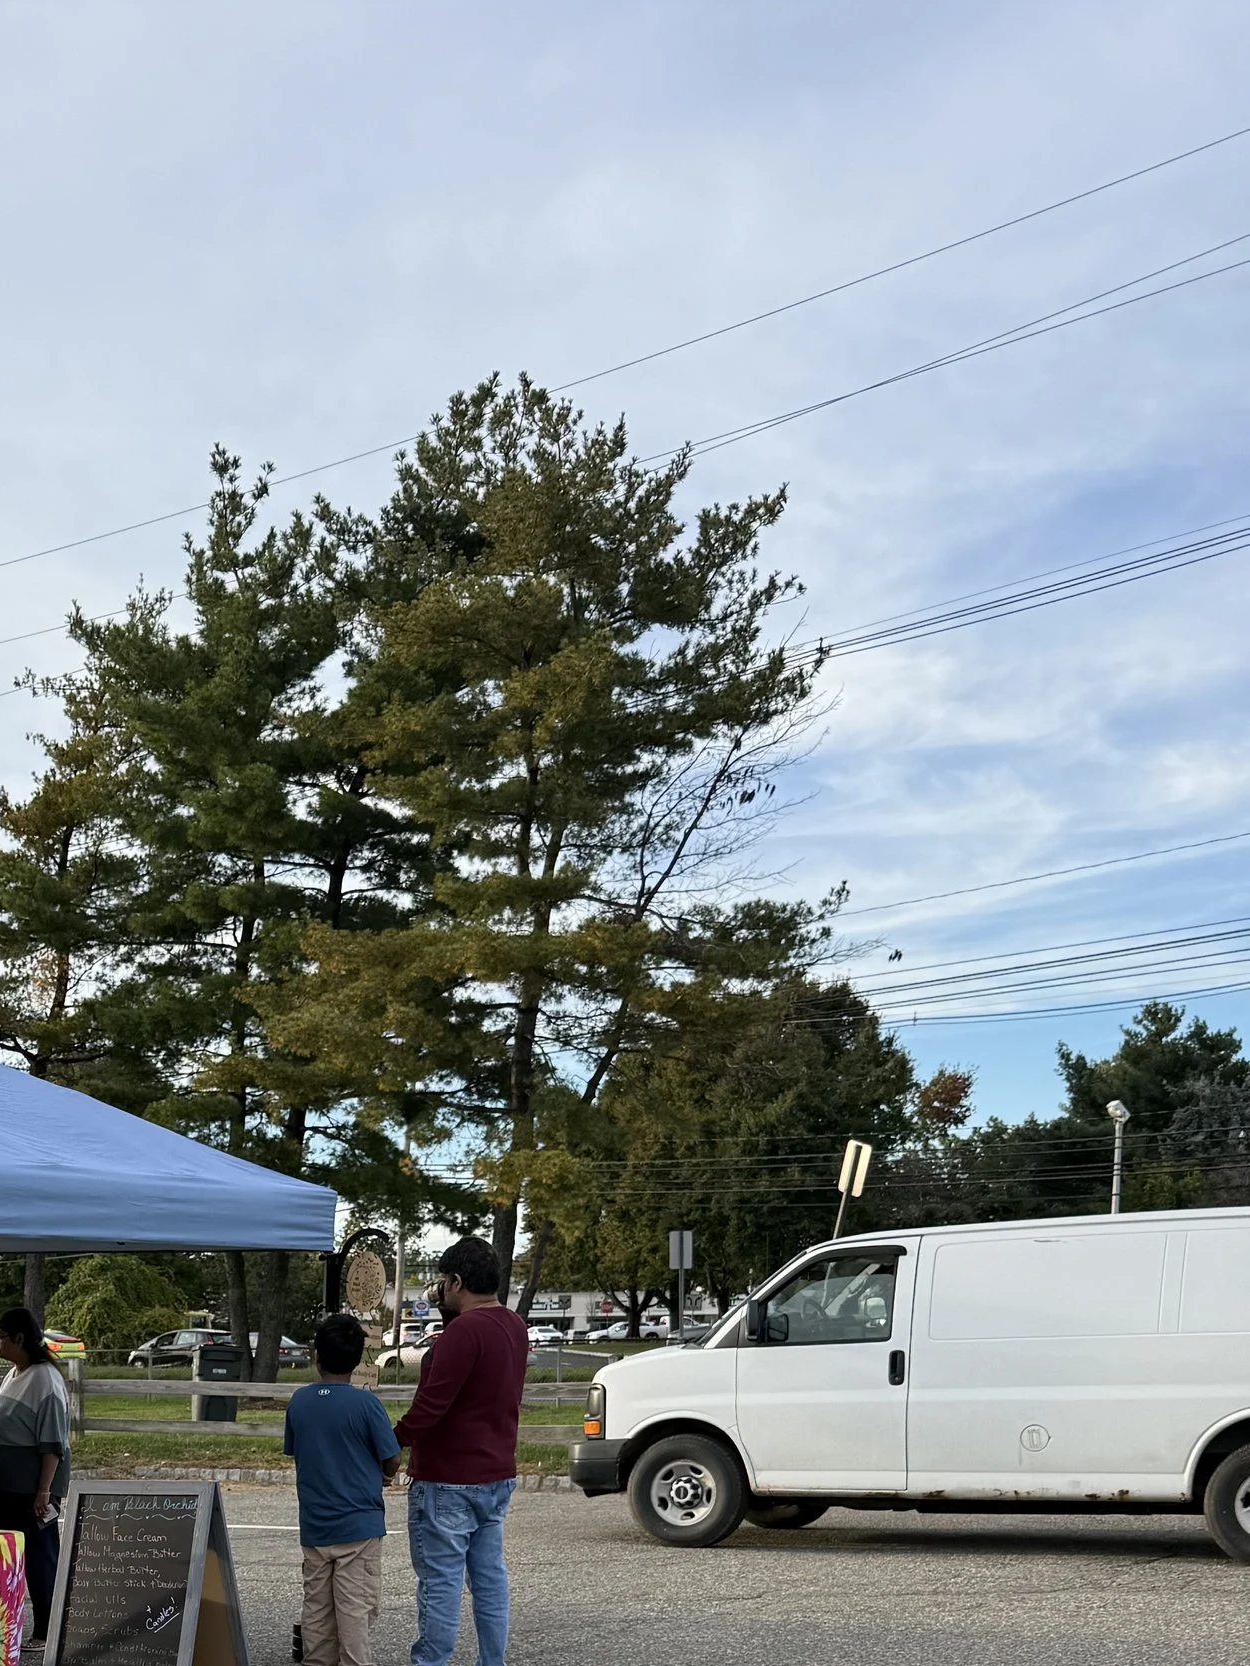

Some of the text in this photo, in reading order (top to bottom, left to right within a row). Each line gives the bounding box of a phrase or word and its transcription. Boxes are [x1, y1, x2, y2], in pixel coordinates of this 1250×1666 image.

[102, 1500, 121, 1512] am
[123, 1495, 160, 1511] Black
[162, 1497, 198, 1512] Orchid
[78, 1522, 168, 1543] Tallow Face Cream
[75, 1541, 101, 1558] Tallow
[148, 1548, 182, 1559] Butter
[124, 1578, 147, 1588] Stick
[65, 1607, 90, 1618] Body
[145, 1596, 178, 1630] Candles!
[101, 1623, 139, 1636] Scrubs
